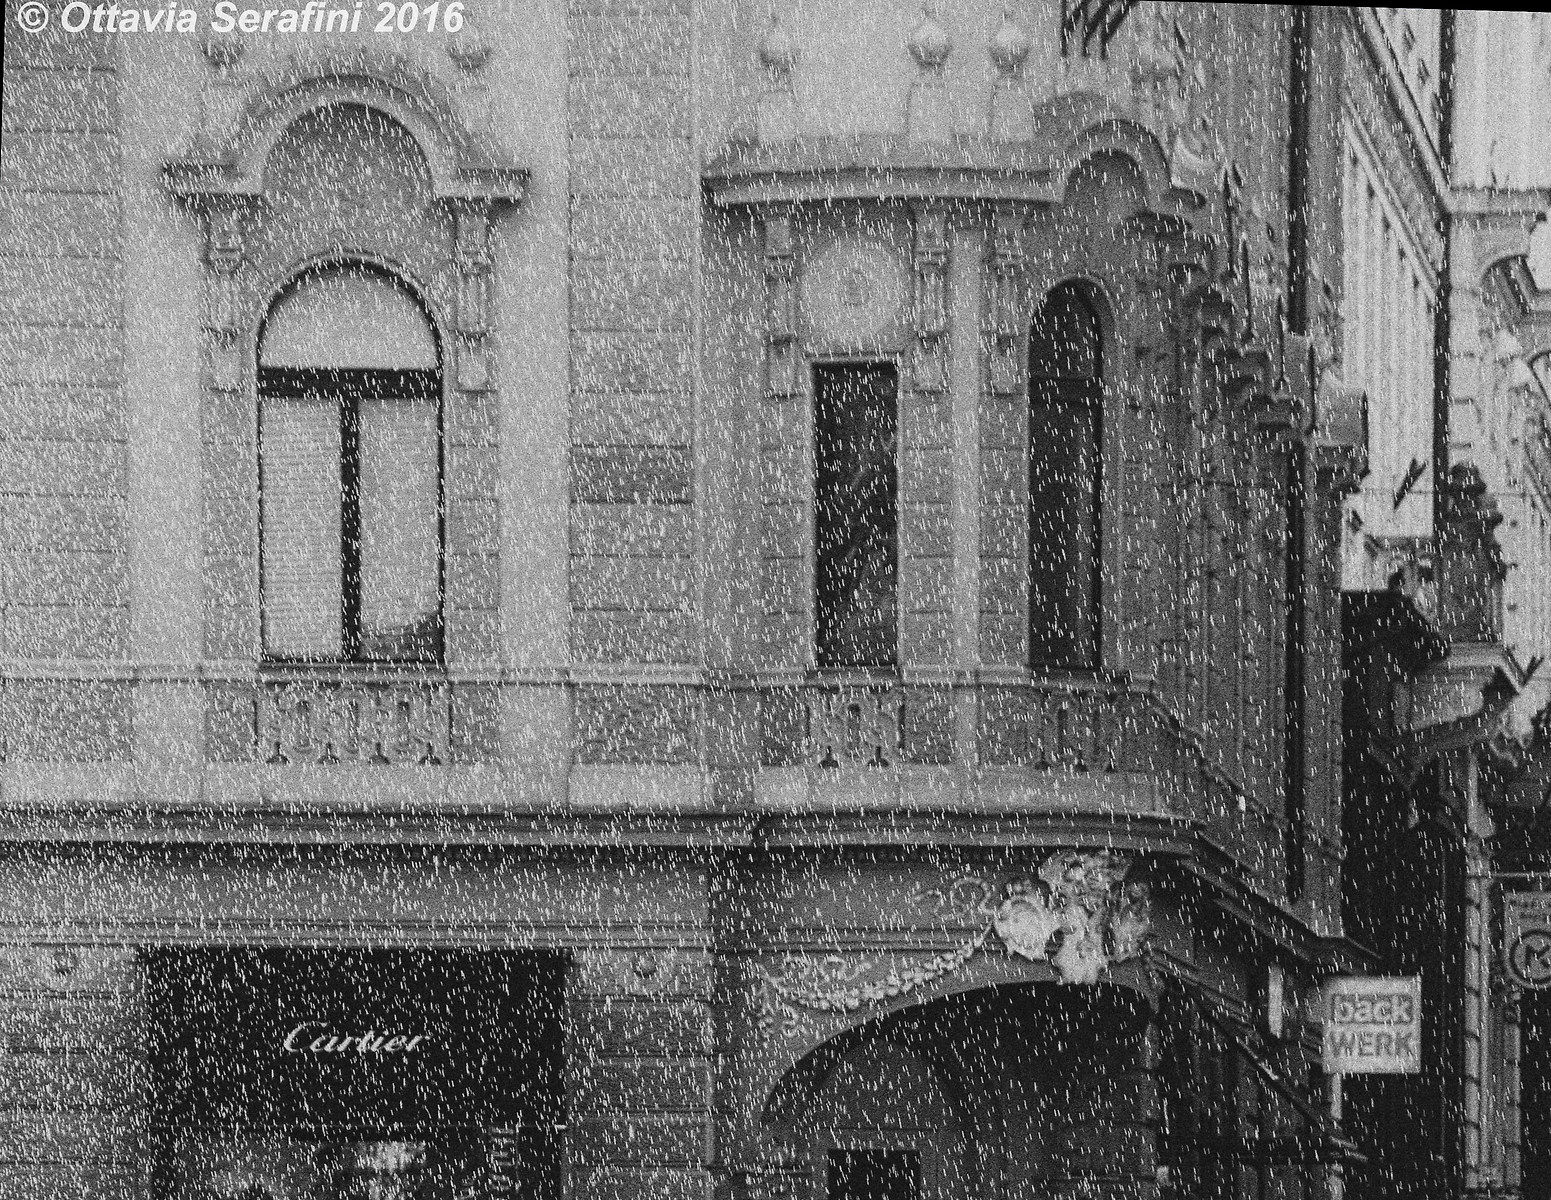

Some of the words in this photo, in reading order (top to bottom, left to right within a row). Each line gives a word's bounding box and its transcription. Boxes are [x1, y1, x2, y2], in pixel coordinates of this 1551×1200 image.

[1333, 995, 1413, 1022] back
[284, 1021, 432, 1053] Cartier
[1328, 1031, 1415, 1057] WERK
